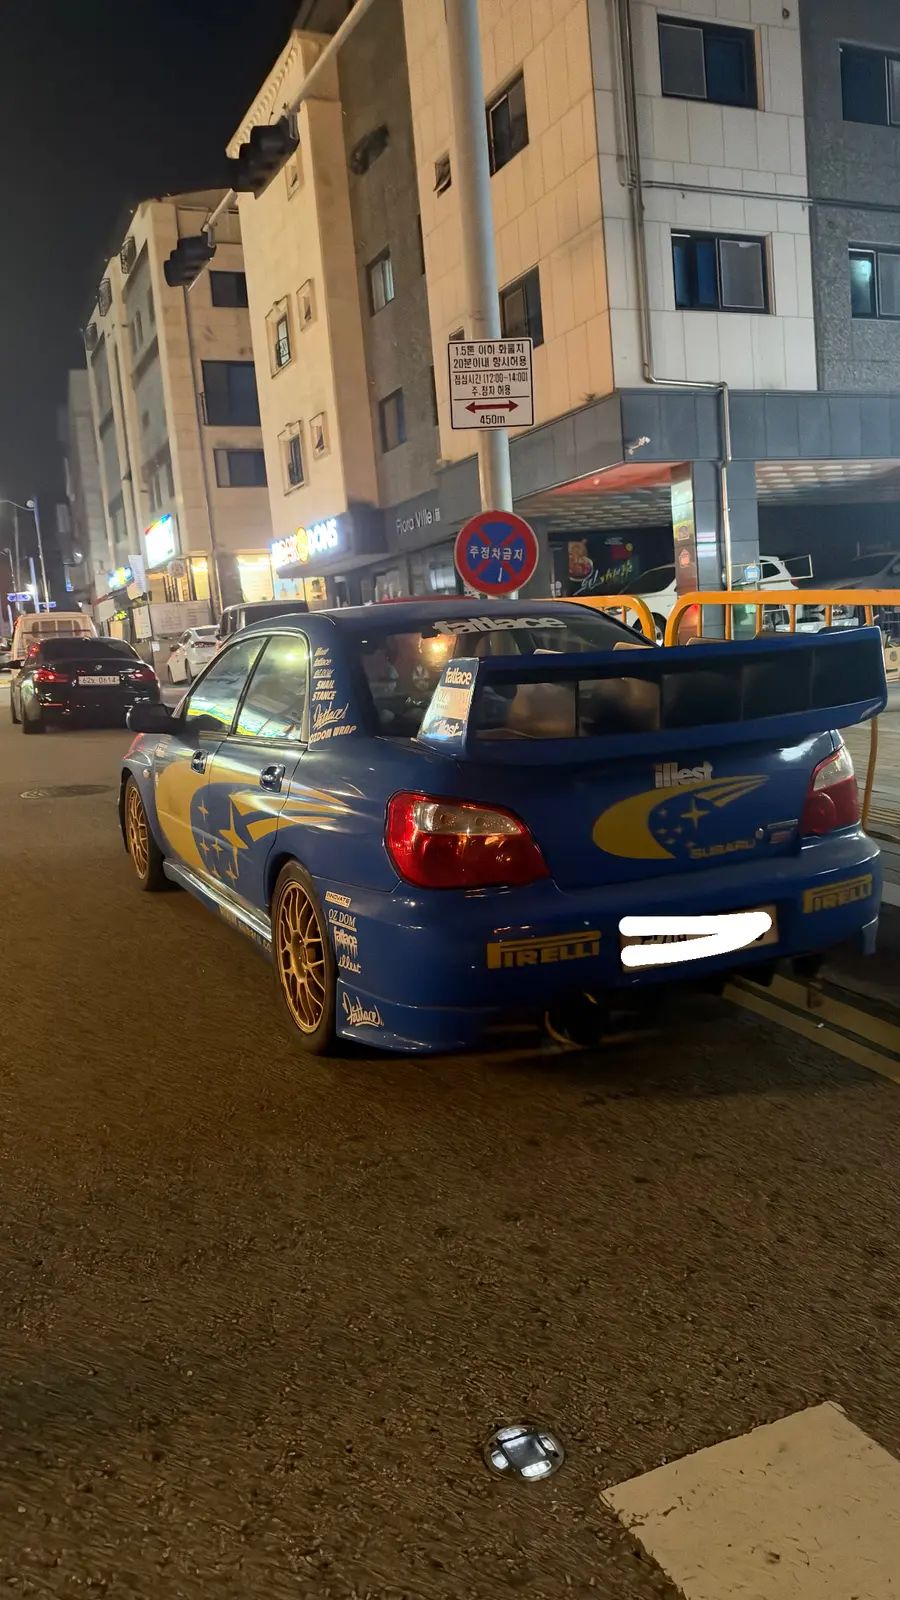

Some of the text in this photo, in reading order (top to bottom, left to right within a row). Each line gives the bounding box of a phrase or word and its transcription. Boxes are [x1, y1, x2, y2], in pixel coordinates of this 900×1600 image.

[478, 344, 495, 355] 이하
[498, 343, 524, 354] 화물차
[453, 355, 527, 369] 20분이내 항시허용
[454, 374, 481, 385] 점심시간
[497, 384, 511, 396] 허용
[479, 414, 506, 425] 450m
[469, 545, 524, 561] 주정차금지
[432, 616, 567, 635] fatlace
[444, 667, 472, 686] fatlace
[312, 691, 337, 701] STANCE
[333, 725, 357, 736] WRAP
[654, 760, 713, 789] illest
[690, 838, 756, 859] SUBARU
[803, 872, 873, 914] PIRELLI
[328, 908, 356, 928] OZ DOM
[486, 930, 602, 969] PIRELLI
